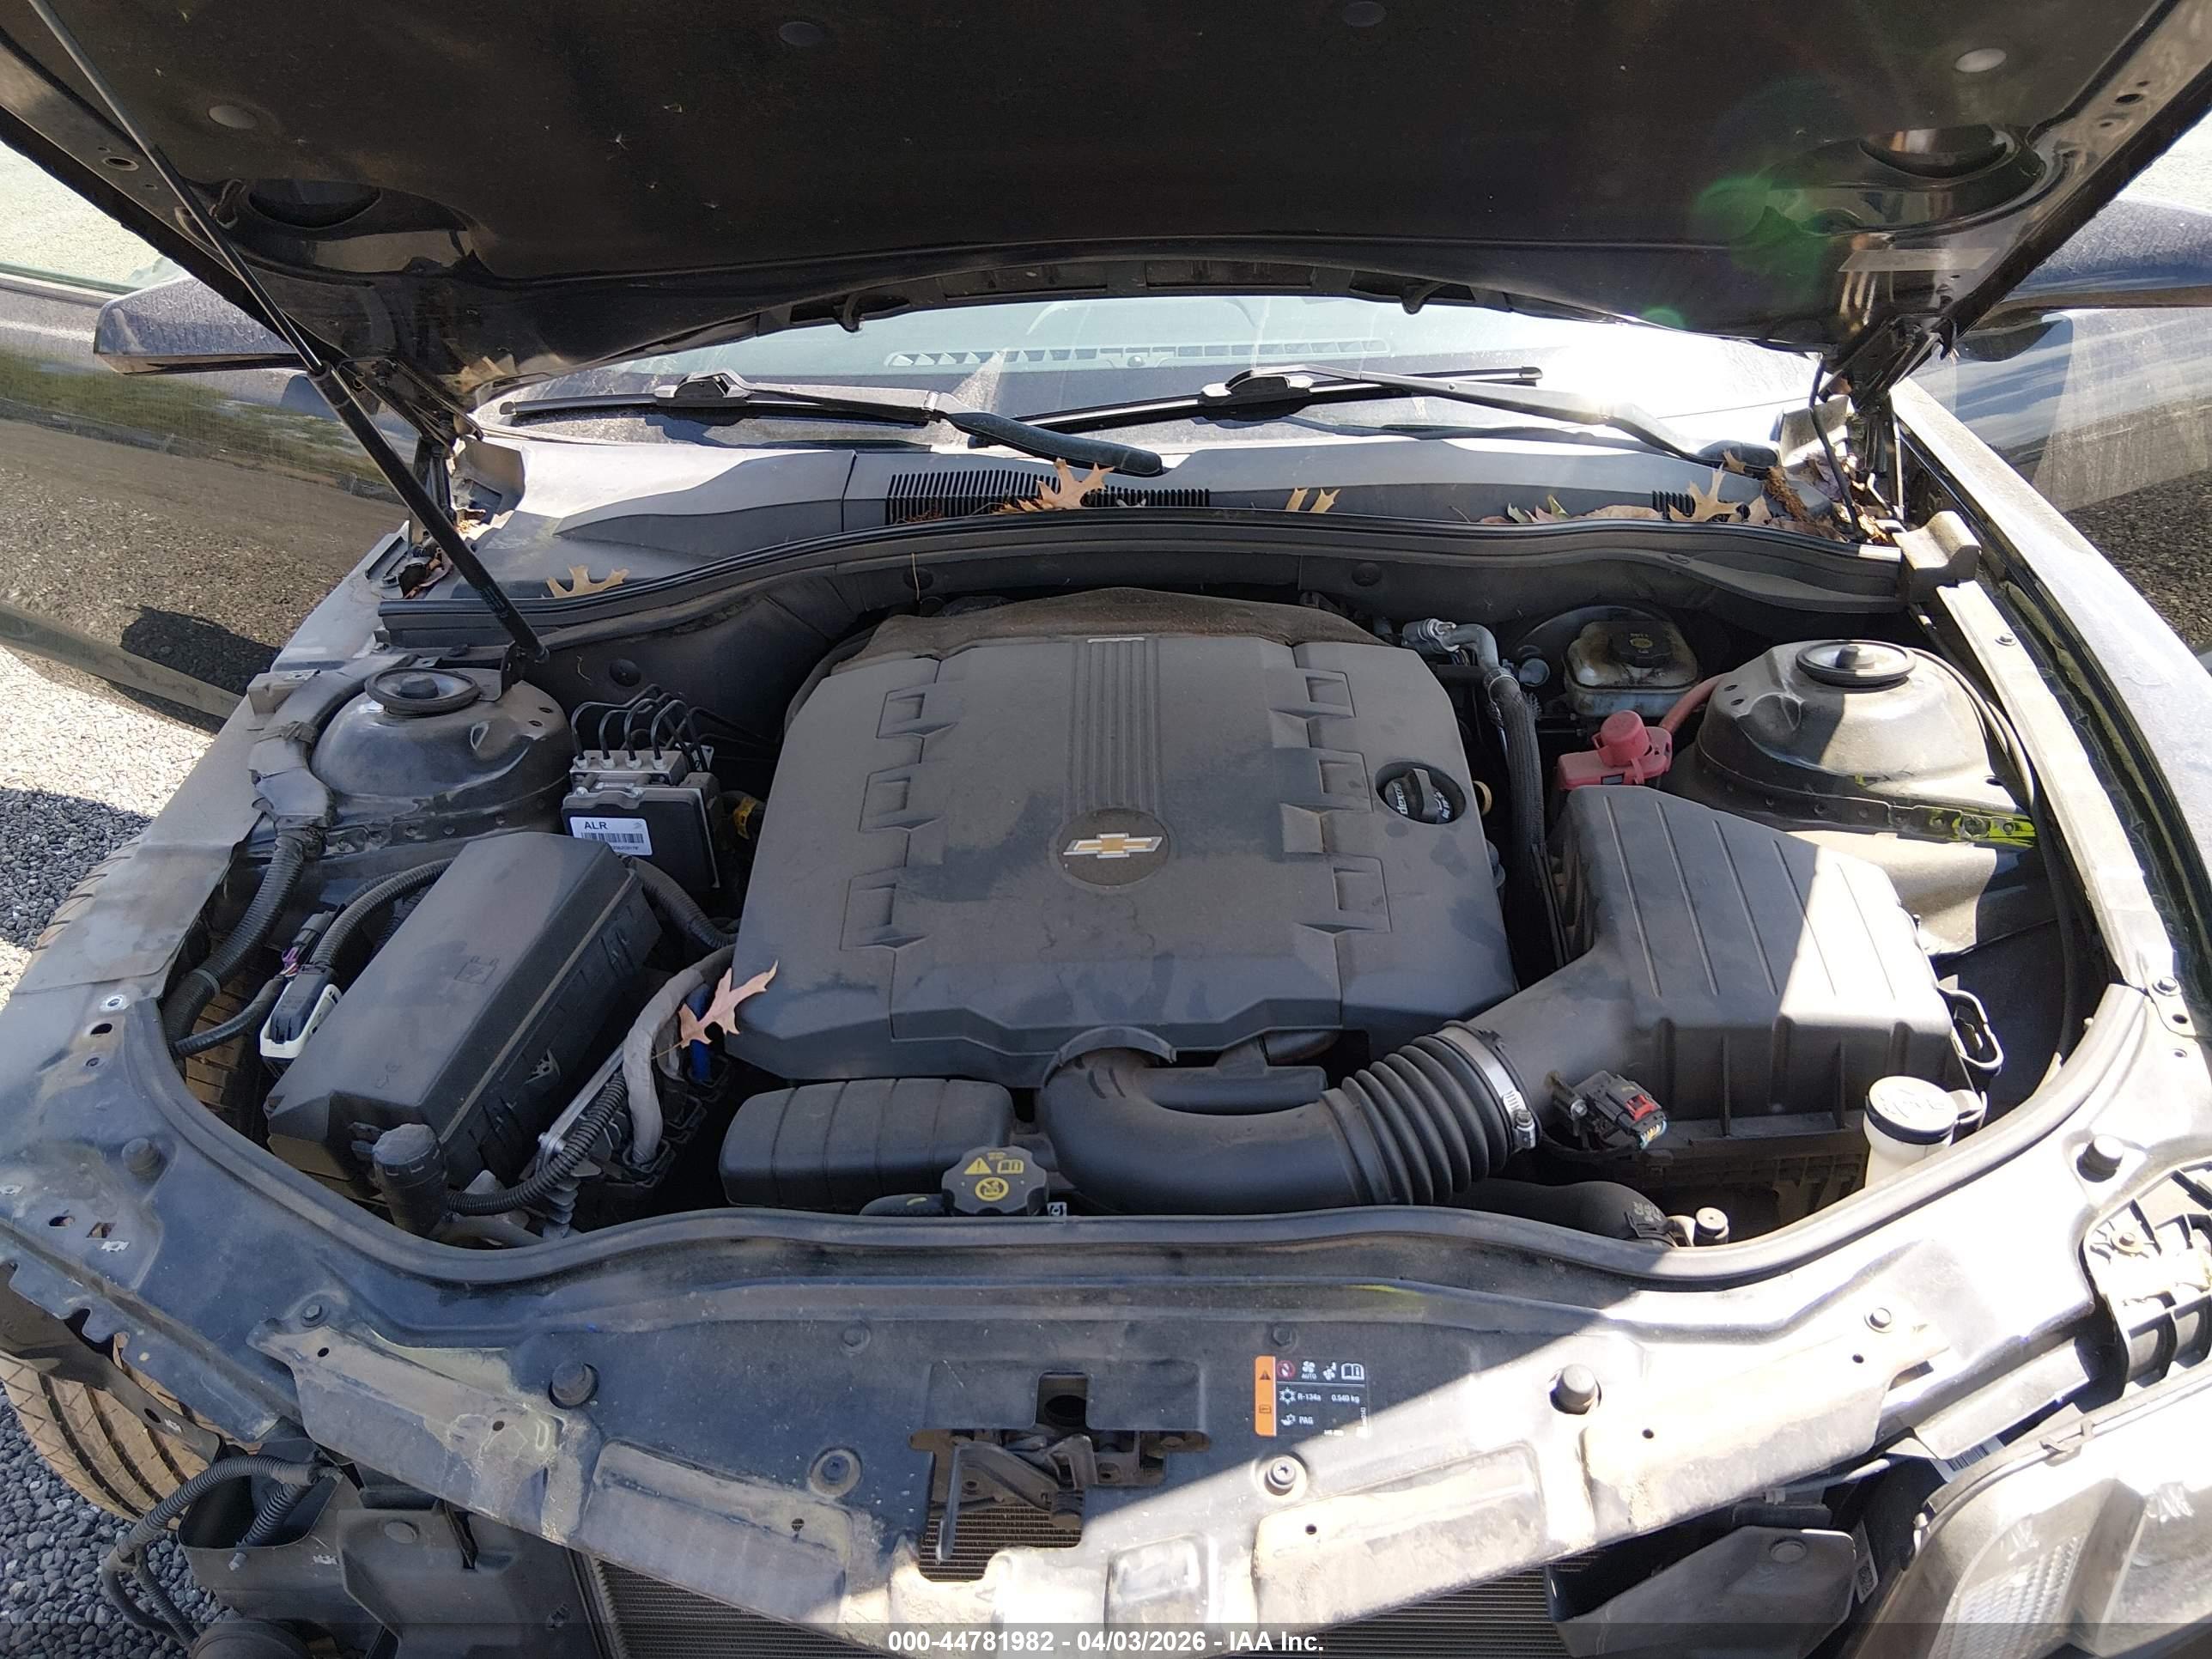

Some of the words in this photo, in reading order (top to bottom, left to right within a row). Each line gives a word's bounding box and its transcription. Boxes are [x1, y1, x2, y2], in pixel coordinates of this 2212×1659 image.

[1392, 782, 1408, 815] dexos
[1297, 1393, 1322, 1401] R-134a
[1351, 1395, 1360, 1404] kg
[1298, 1416, 1314, 1425] PAG
